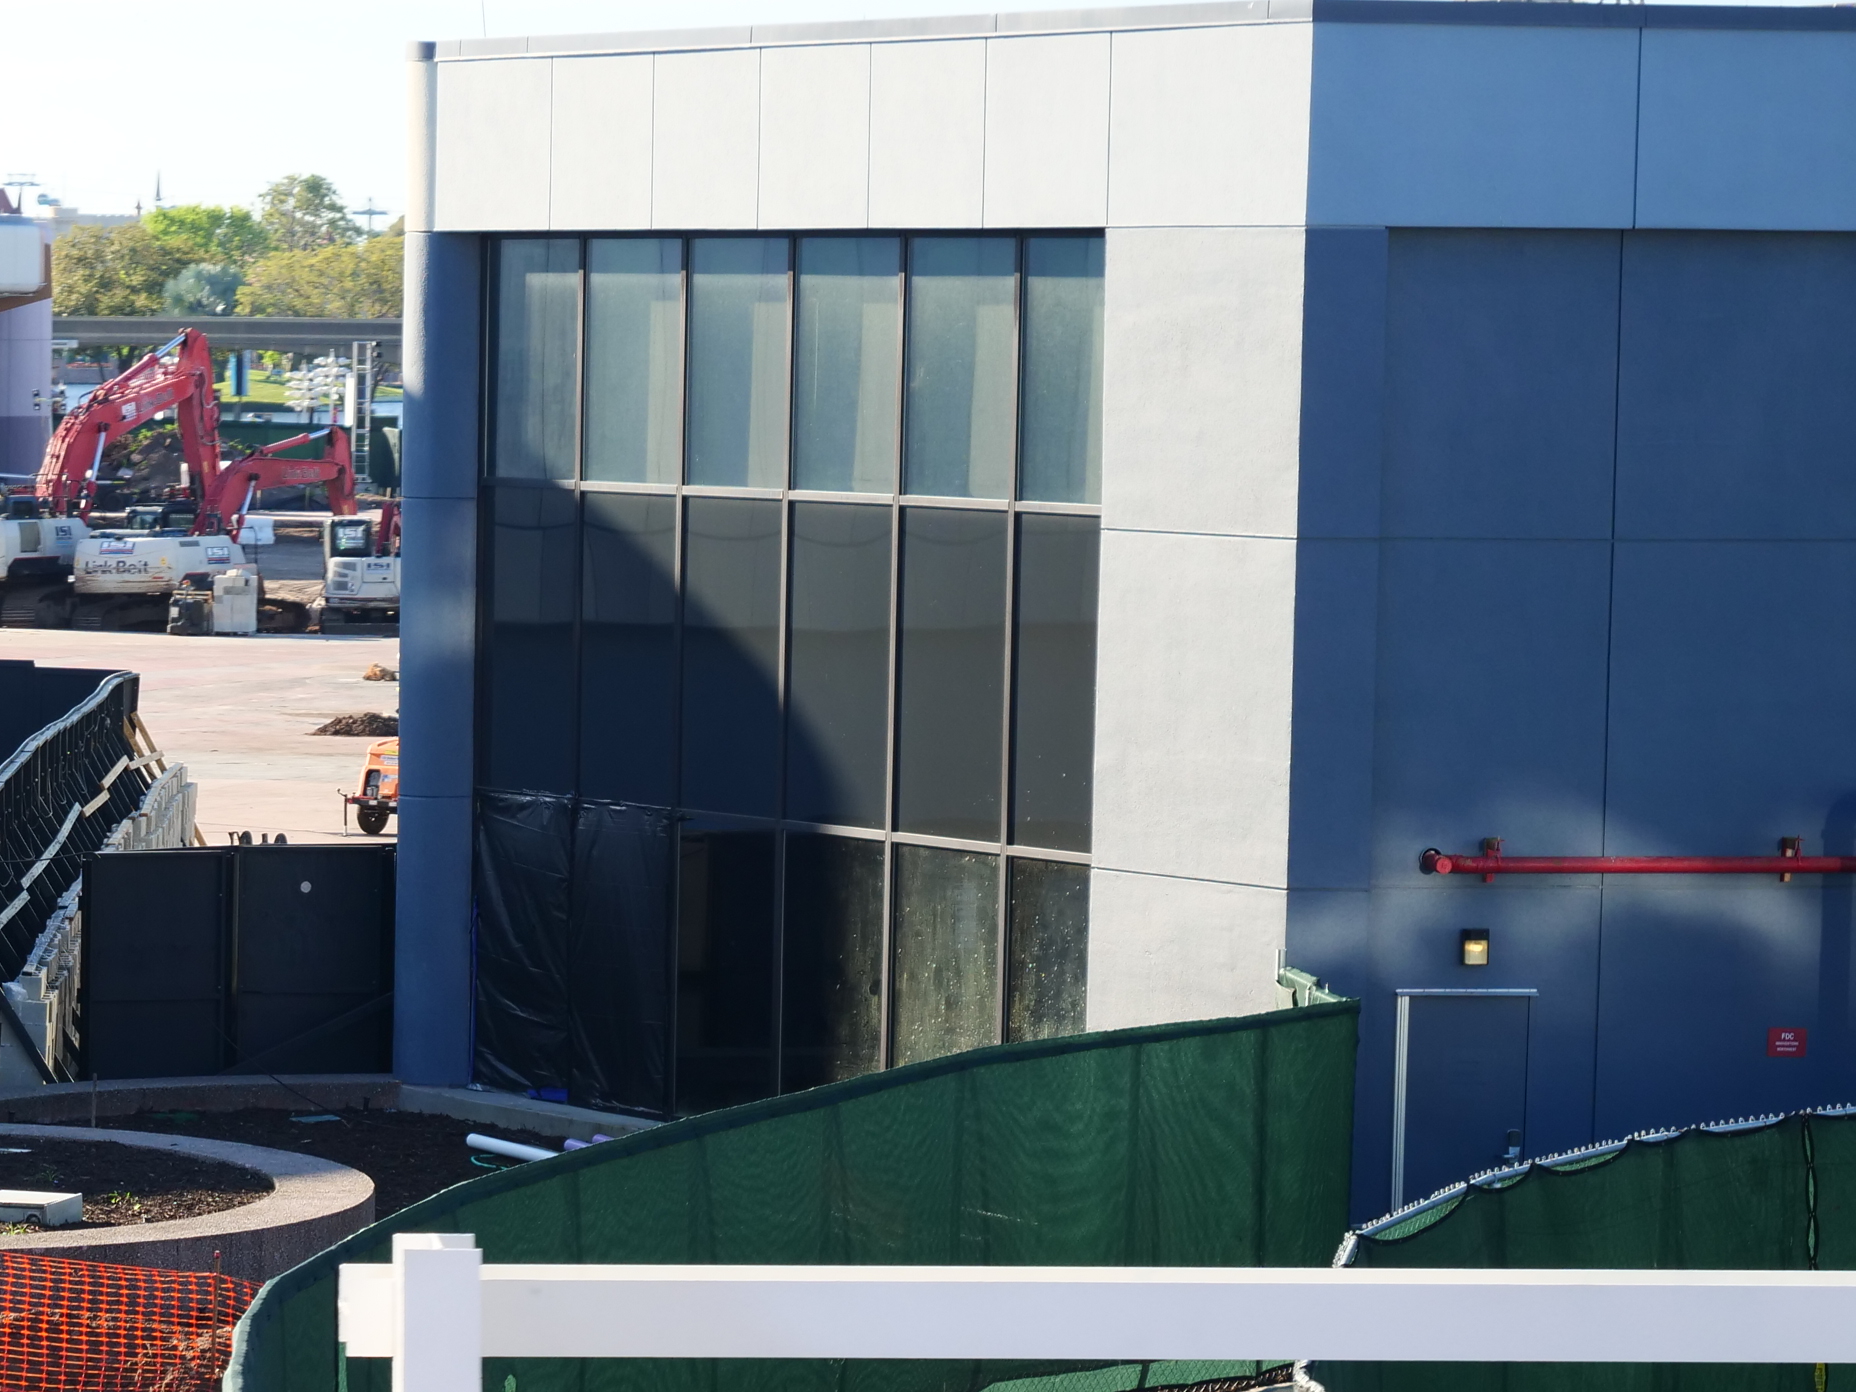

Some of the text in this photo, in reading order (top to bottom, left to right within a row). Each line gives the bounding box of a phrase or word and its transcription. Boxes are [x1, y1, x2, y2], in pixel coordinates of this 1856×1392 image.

[54, 525, 72, 536] ISI
[207, 547, 229, 555] ISI
[1781, 1032, 1795, 1040] FDC
